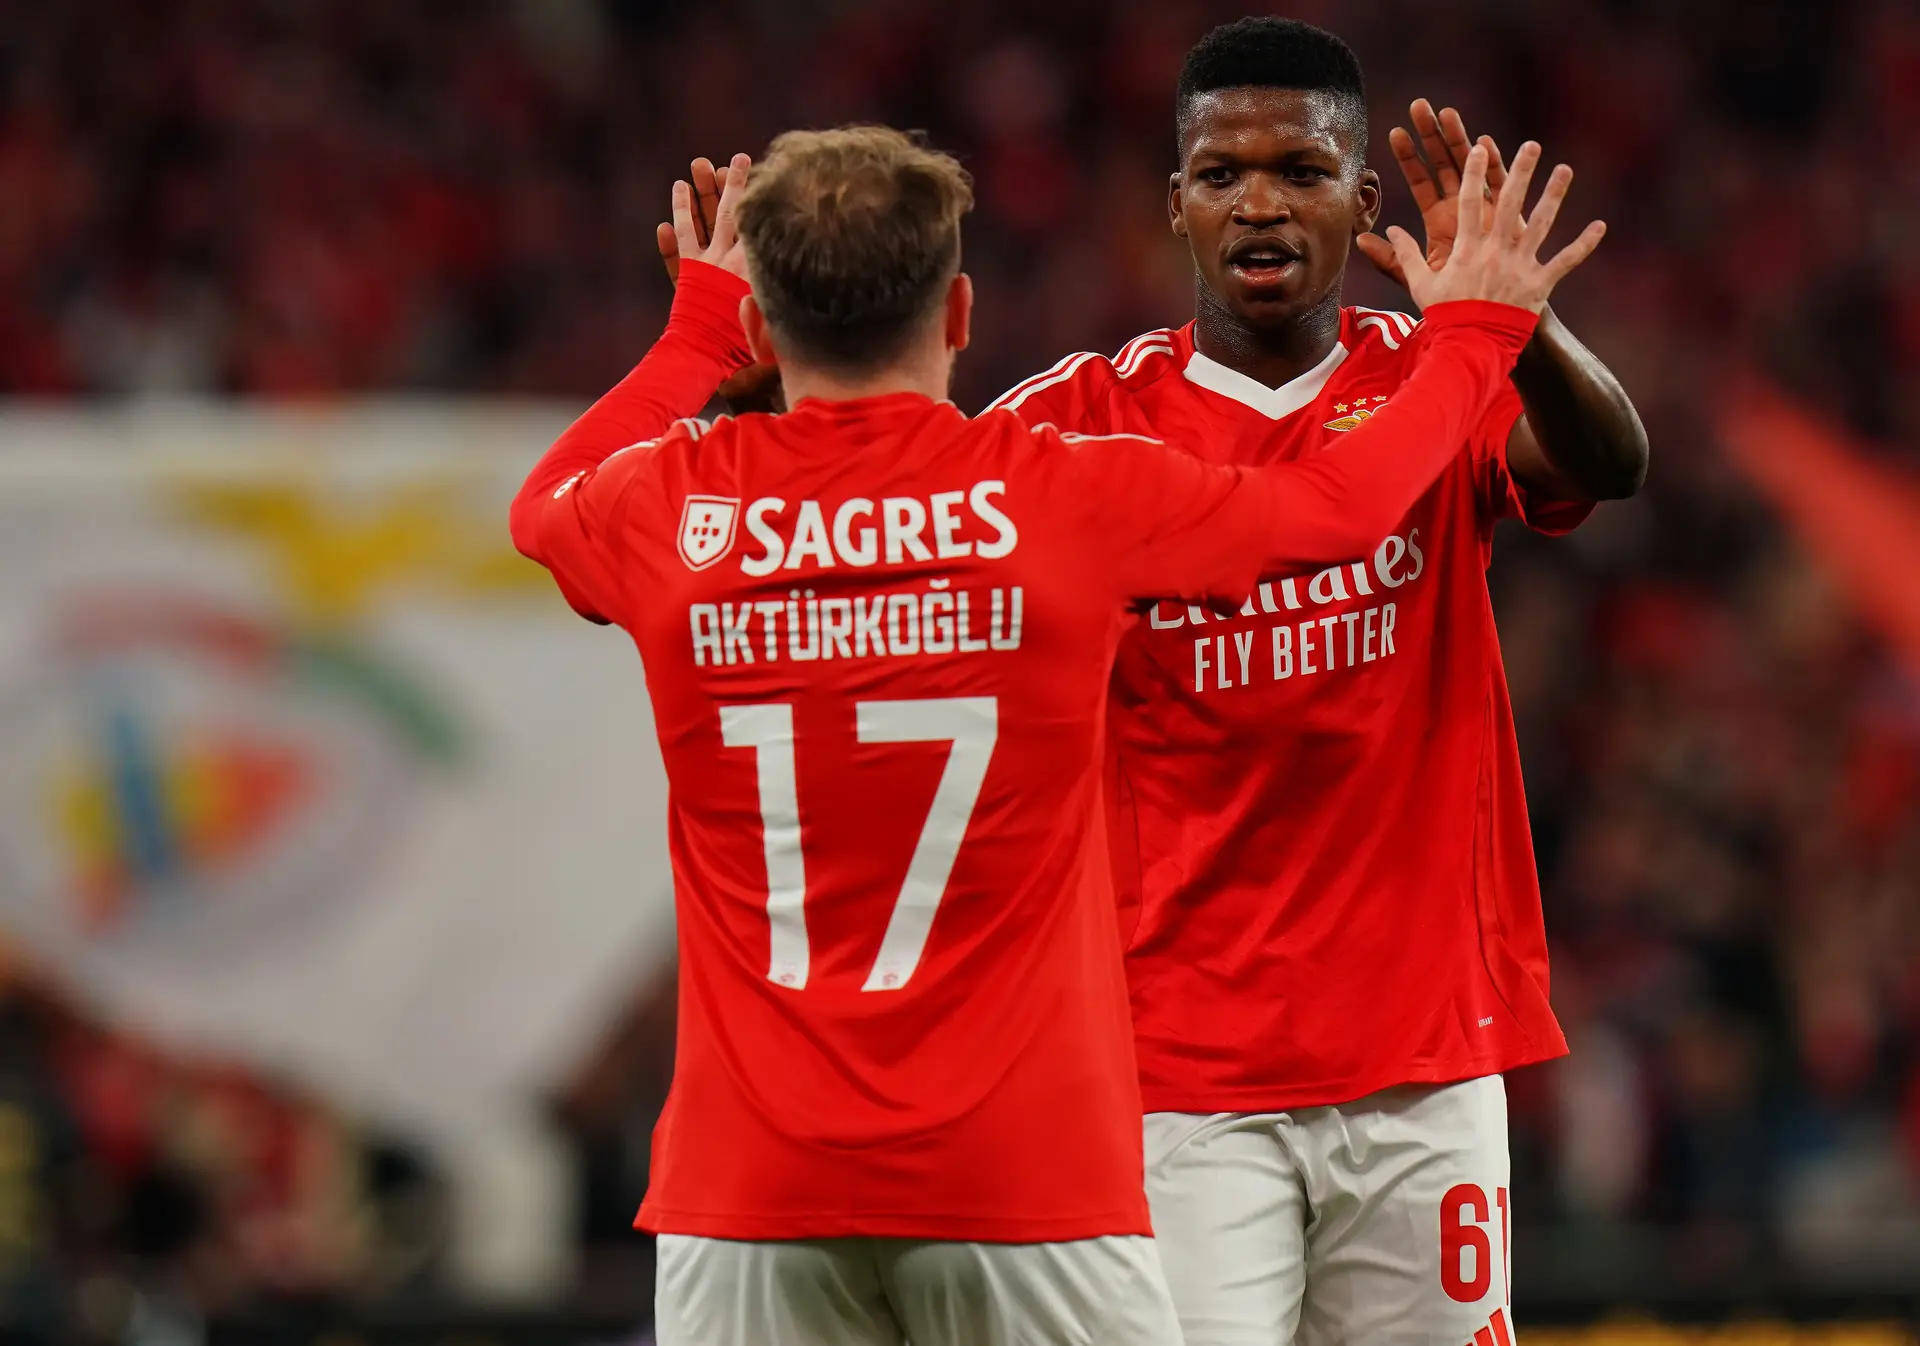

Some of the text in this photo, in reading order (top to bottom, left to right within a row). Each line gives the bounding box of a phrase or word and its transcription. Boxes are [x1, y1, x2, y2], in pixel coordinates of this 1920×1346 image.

[740, 480, 1018, 577] SAGRES
[689, 578, 1024, 666] AKTÜRKOĞLU
[1194, 602, 1397, 692] FLY BETTER
[718, 696, 998, 992] 17
[1440, 1183, 1509, 1306] 61
